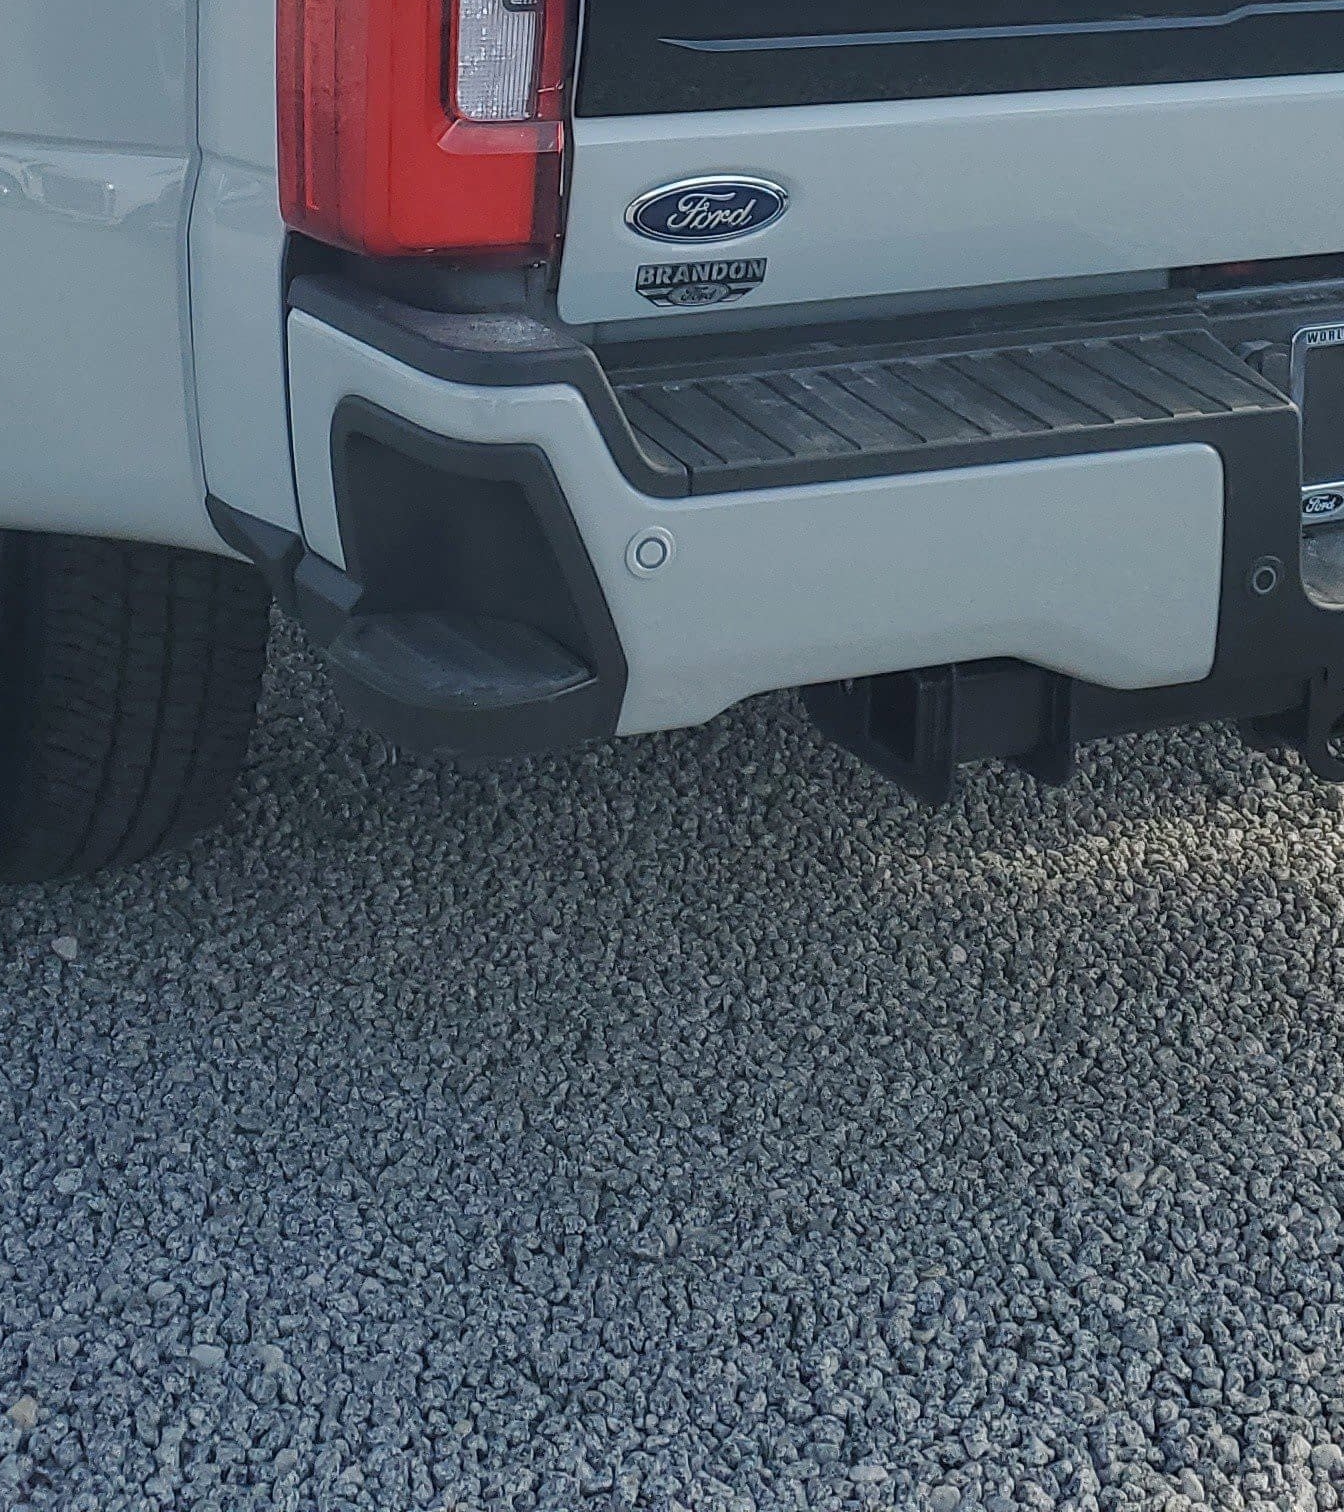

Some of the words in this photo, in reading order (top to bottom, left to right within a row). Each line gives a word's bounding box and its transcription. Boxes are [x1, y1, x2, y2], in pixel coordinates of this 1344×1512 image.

[667, 192, 756, 230] Ford
[637, 258, 766, 286] BRANDON
[1305, 492, 1335, 513] Ford
